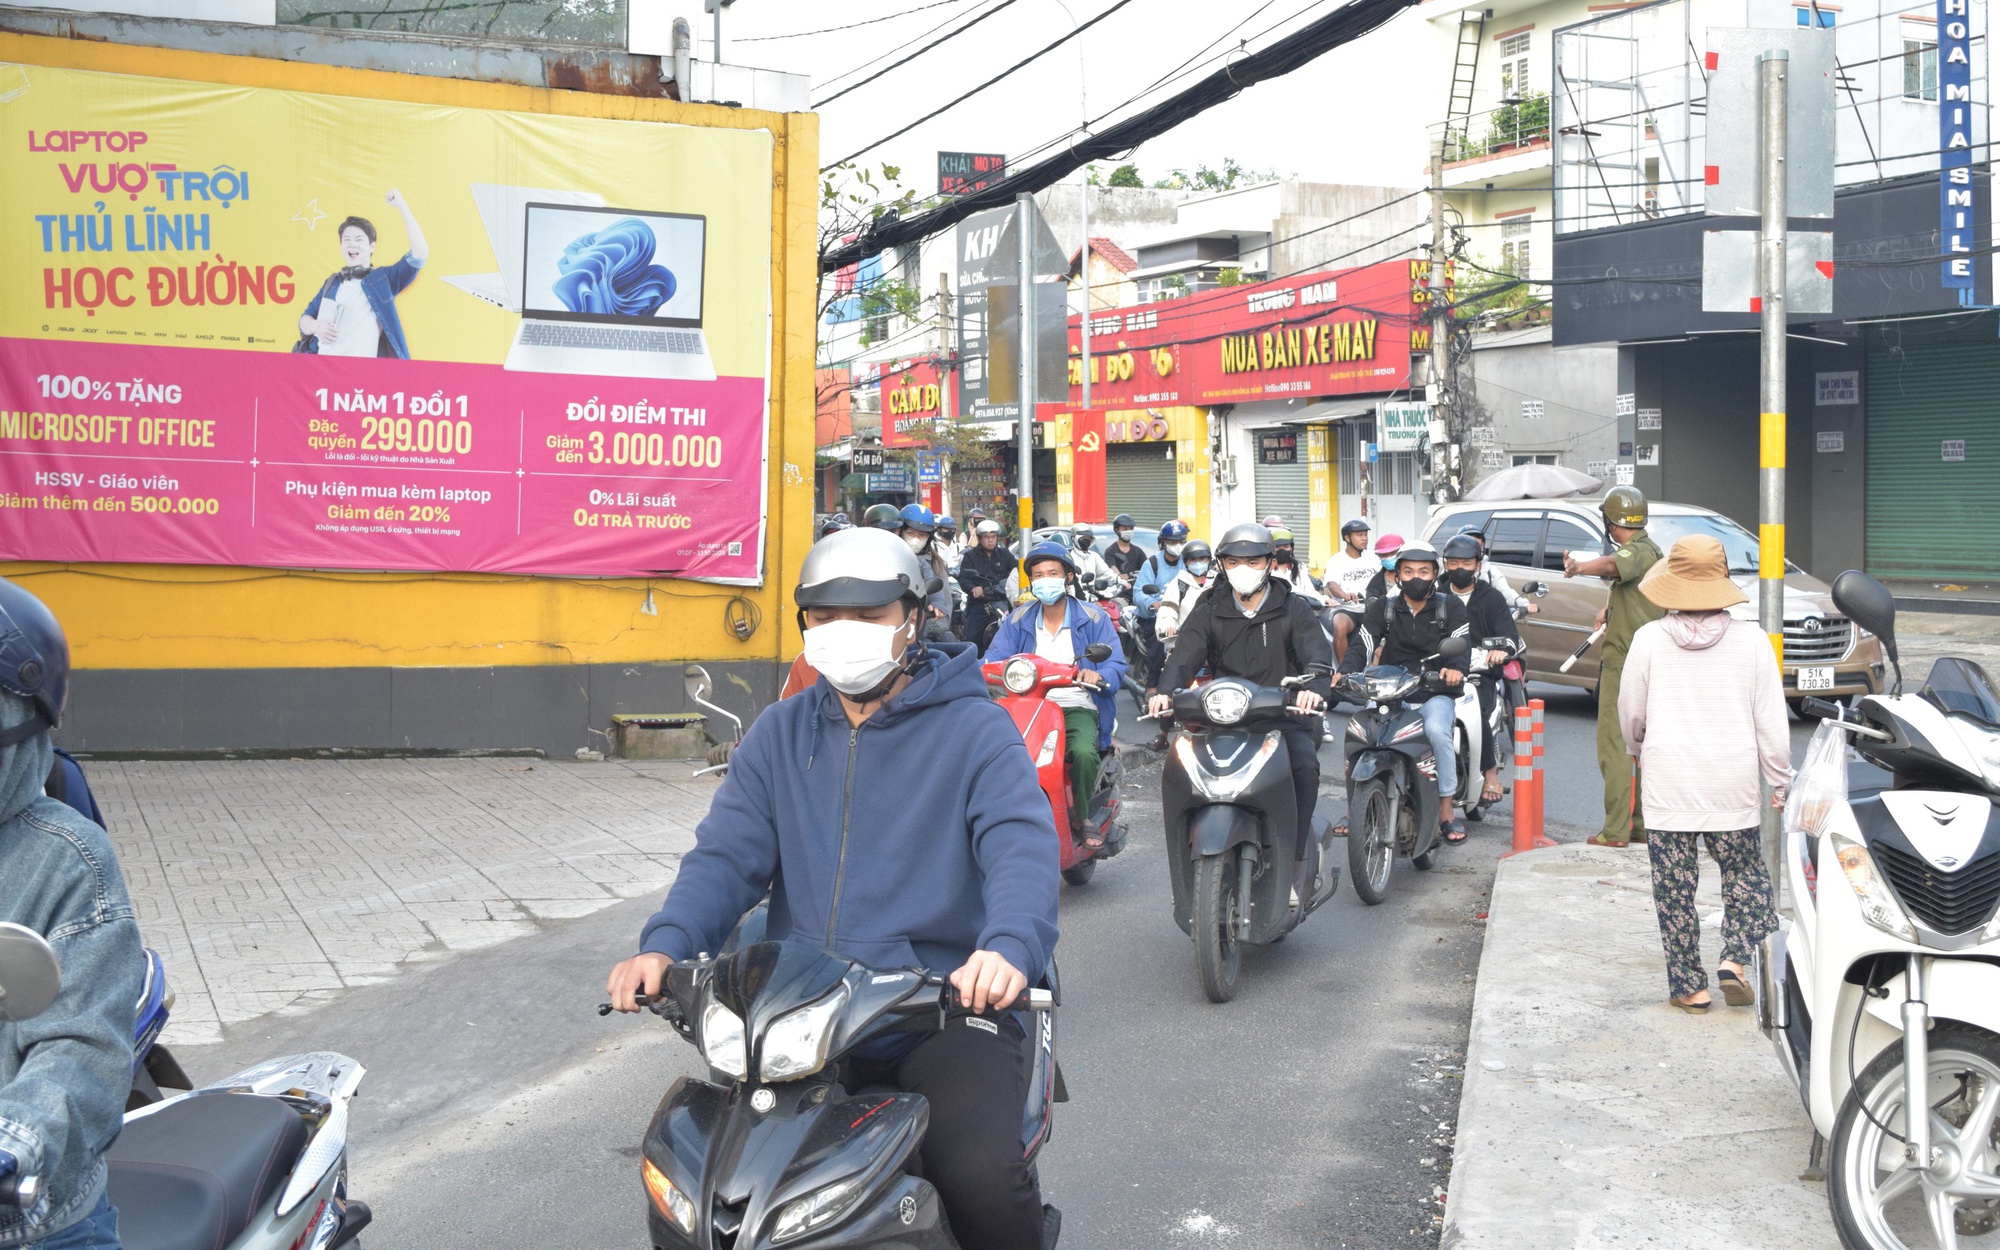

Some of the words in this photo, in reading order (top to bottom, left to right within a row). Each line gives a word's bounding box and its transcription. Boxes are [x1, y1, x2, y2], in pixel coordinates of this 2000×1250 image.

[1946, 83, 1969, 148] MIA
[29, 130, 148, 153] LAPTOP
[941, 154, 971, 174] KHÁI
[58, 162, 177, 202] VƯỢT
[155, 164, 250, 209] TRỘI
[35, 201, 113, 252] THỦ
[124, 206, 210, 252] LĨNH
[1947, 167, 1971, 276] SMILE
[43, 266, 137, 317] HỌC
[146, 253, 296, 307] ĐƯỜNG
[1247, 287, 1296, 313] TRUNG
[1301, 281, 1337, 306] NAM
[1221, 334, 1260, 374] MUA
[1262, 317, 1302, 370] BÁN
[1305, 323, 1332, 366] XE
[36, 374, 112, 401] 100%
[115, 377, 182, 407] TẶNG
[316, 388, 328, 411] 1
[334, 389, 387, 414] NĂM
[392, 391, 404, 414] 1
[409, 390, 450, 417] ĐỔI
[455, 395, 468, 417] 1
[566, 396, 606, 422] ĐỔI
[610, 398, 666, 424] ĐIỂM
[670, 407, 706, 427] THI
[1130, 408, 1169, 440] ĐỒ
[1385, 407, 1401, 428] NHÀ
[1402, 404, 1426, 428] THUỐC
[0, 410, 132, 444] MICROSOFT
[138, 416, 216, 448] OFFICE
[308, 419, 339, 436] Đặc
[308, 433, 356, 450] quyền
[361, 416, 472, 454] 299.000
[546, 435, 584, 450] Giảm
[588, 430, 722, 468] 3.000.000
[1263, 438, 1279, 448] MUA
[400, 455, 409, 463] do
[410, 455, 424, 463] Nhà
[555, 449, 584, 464] đến
[1266, 450, 1275, 461] XE
[1277, 449, 1292, 460] MÁY
[1310, 450, 1327, 471] BÁN
[35, 471, 84, 487] HSSV
[99, 473, 138, 490] Giáo
[142, 475, 179, 490] viên
[1314, 478, 1324, 495] XE
[285, 480, 318, 498] Phụ
[322, 482, 358, 500] kiện
[361, 487, 398, 499] mua
[401, 483, 436, 500] kèm
[440, 486, 492, 505] laptop
[589, 489, 615, 506] 0%
[617, 492, 639, 507] Lãi
[643, 490, 677, 508] suất
[43, 494, 88, 511] thêm
[93, 495, 126, 512] đến
[130, 496, 219, 515] 500.000
[327, 504, 370, 520] Giảm
[374, 505, 405, 521] đến
[408, 505, 451, 523] 20%
[1309, 498, 1327, 519] MÁY
[573, 508, 599, 527] 0đ
[602, 511, 633, 528] TRẢ
[636, 513, 692, 529] TRƯỚC
[315, 524, 339, 533] Không
[340, 524, 349, 534] áp
[350, 525, 369, 534] dụng
[440, 529, 461, 537] mạng
[1801, 678, 1830, 689] 730.28
[1808, 668, 1824, 679] 51K
